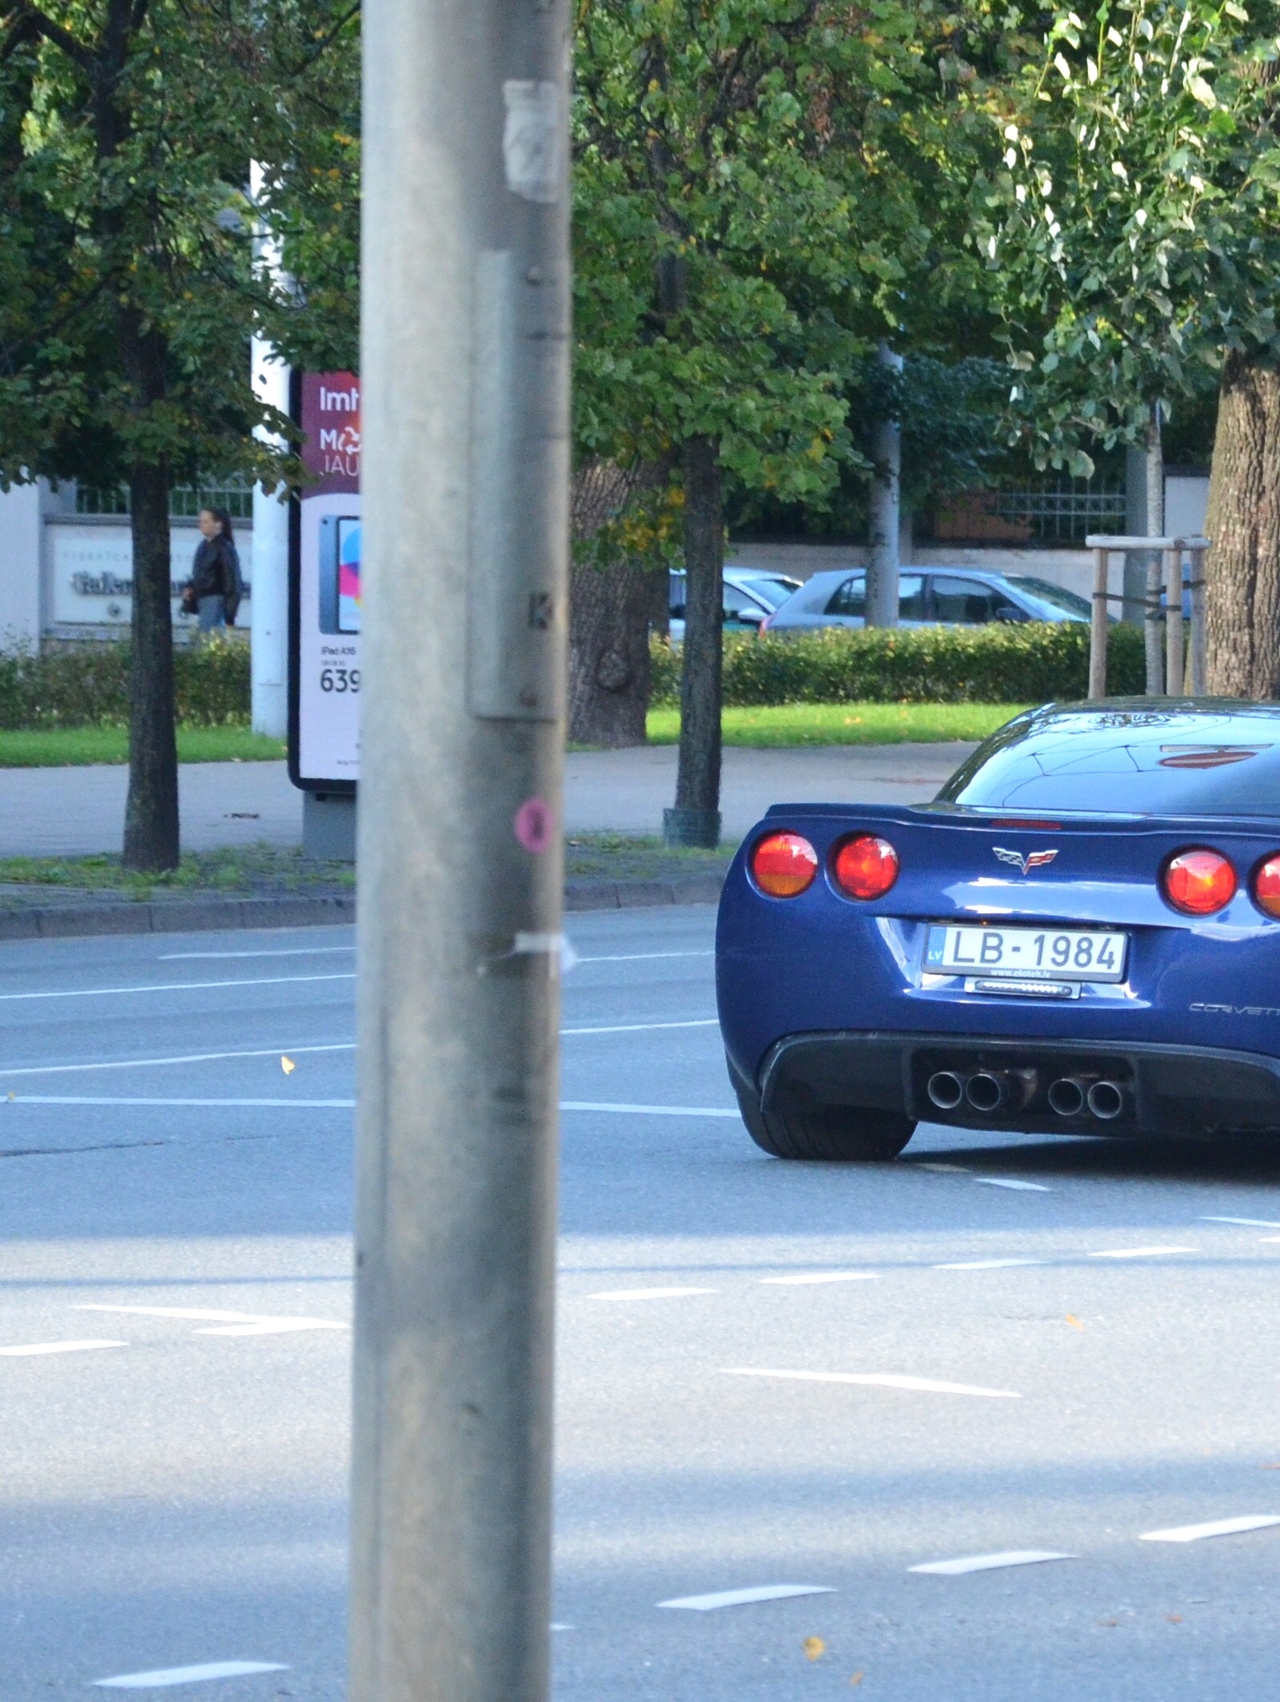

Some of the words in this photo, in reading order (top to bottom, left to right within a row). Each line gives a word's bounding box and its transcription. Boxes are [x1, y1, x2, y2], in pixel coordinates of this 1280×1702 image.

[321, 669, 360, 692] 639
[928, 950, 943, 960] LV
[953, 931, 1115, 970] LB-1984
[990, 968, 1051, 978] www.ekoteh.lv
